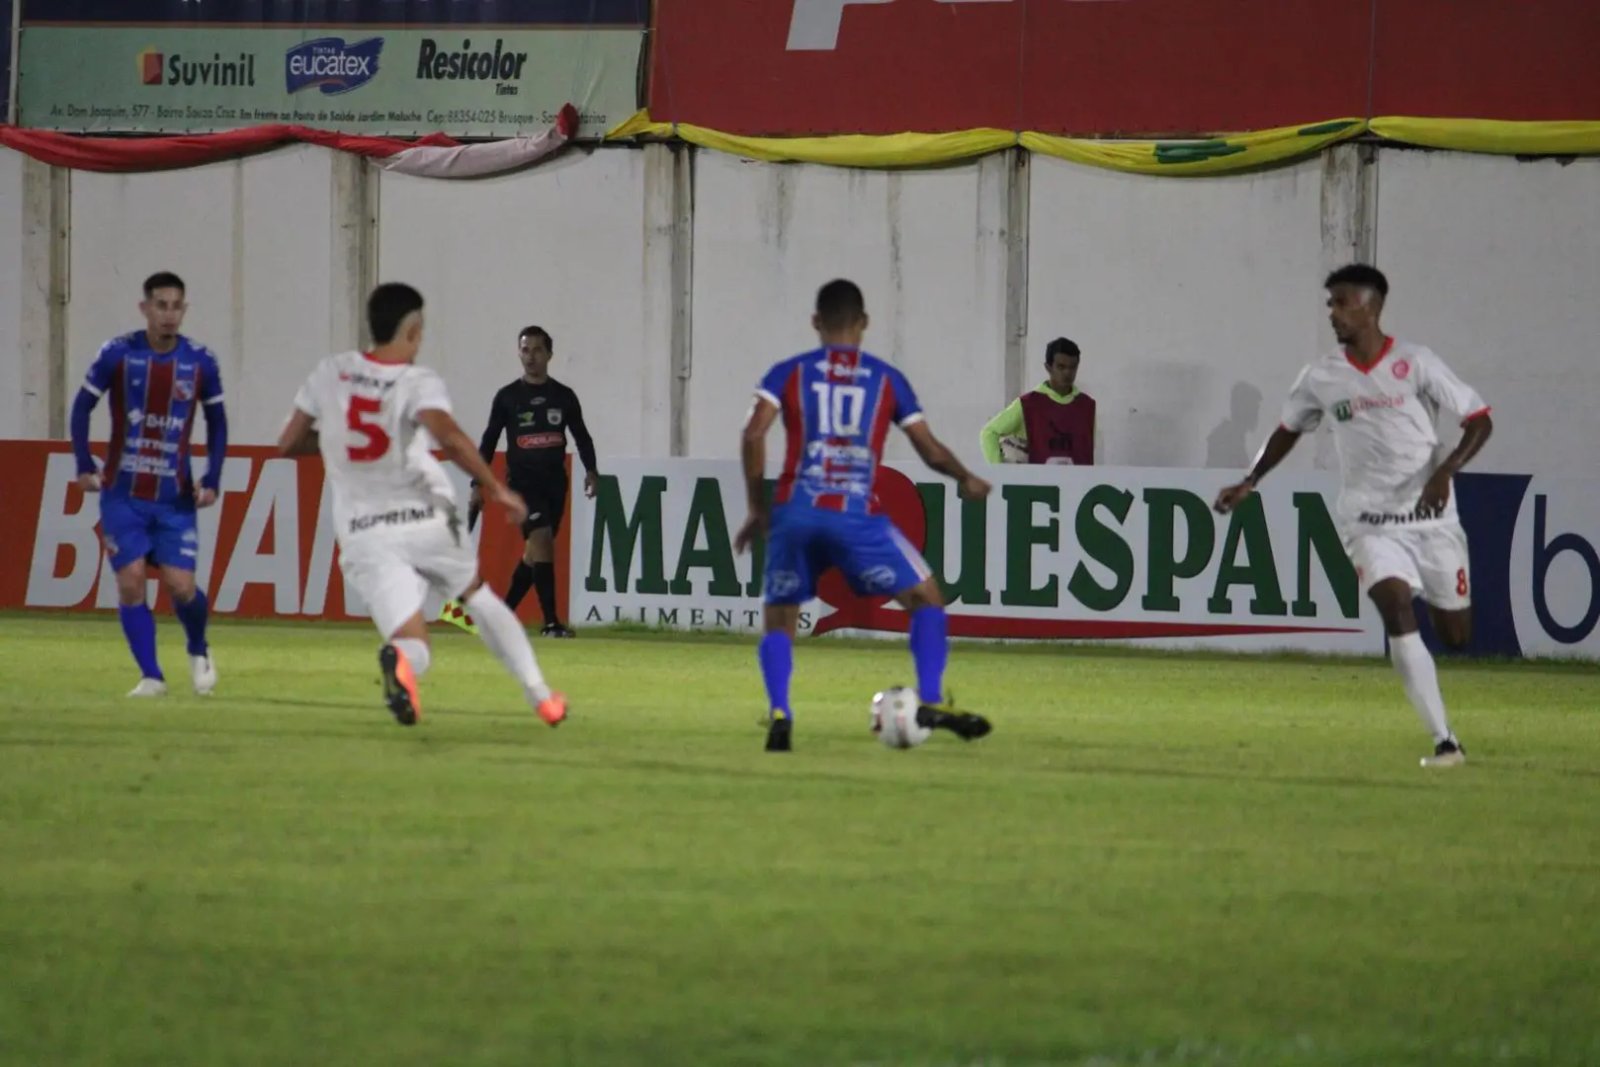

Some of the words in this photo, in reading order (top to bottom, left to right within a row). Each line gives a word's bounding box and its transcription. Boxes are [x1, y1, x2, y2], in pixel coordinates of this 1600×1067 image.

[168, 53, 255, 87] Suvinil
[290, 53, 370, 76] eucatex
[416, 38, 528, 80] Resicolor
[132, 104, 149, 117] 577
[811, 381, 866, 437] 10
[346, 394, 391, 462] 5
[25, 452, 484, 622] BTA
[1456, 568, 1468, 597] 8
[586, 604, 812, 630] ALIMENTS
